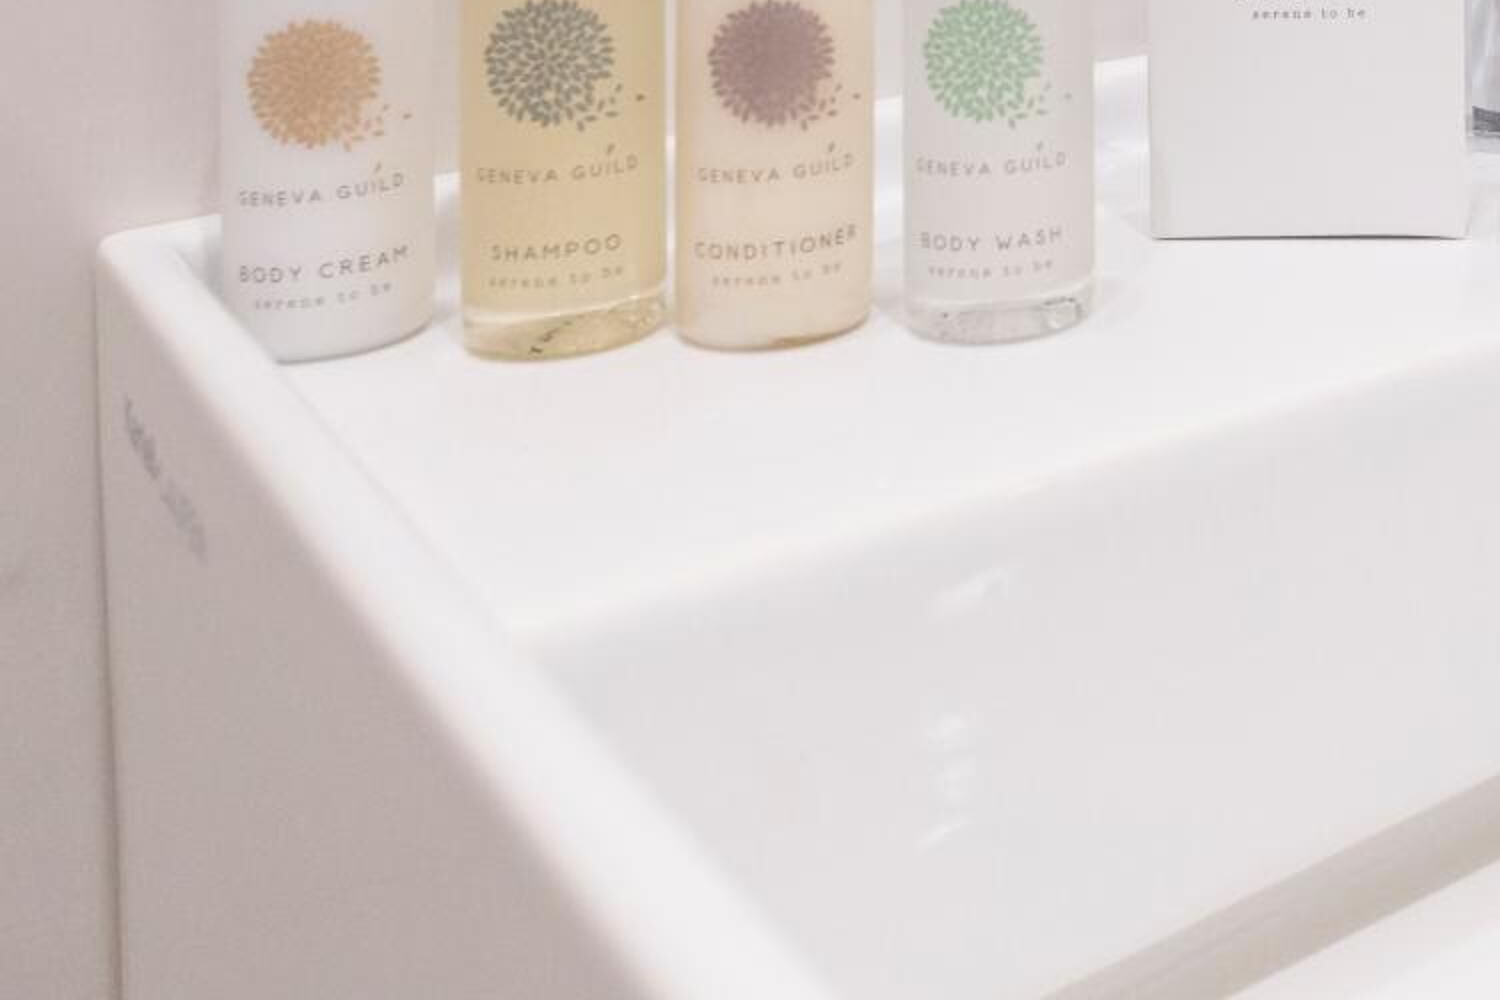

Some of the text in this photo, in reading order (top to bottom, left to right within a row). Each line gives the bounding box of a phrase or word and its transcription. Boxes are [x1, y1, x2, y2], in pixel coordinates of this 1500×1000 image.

[1252, 6, 1366, 21] serene to be
[477, 153, 638, 185] GENEVA GUILD
[698, 152, 853, 184] GENEVA GUILD
[916, 151, 1067, 177] GENEVA GUILD
[239, 172, 404, 208] GENEVA GUILD
[491, 233, 622, 262] SHAMPOO
[694, 223, 857, 261] CONDITIONER
[920, 225, 1062, 251] BODY WASH
[239, 245, 408, 284] BODY CREAM
